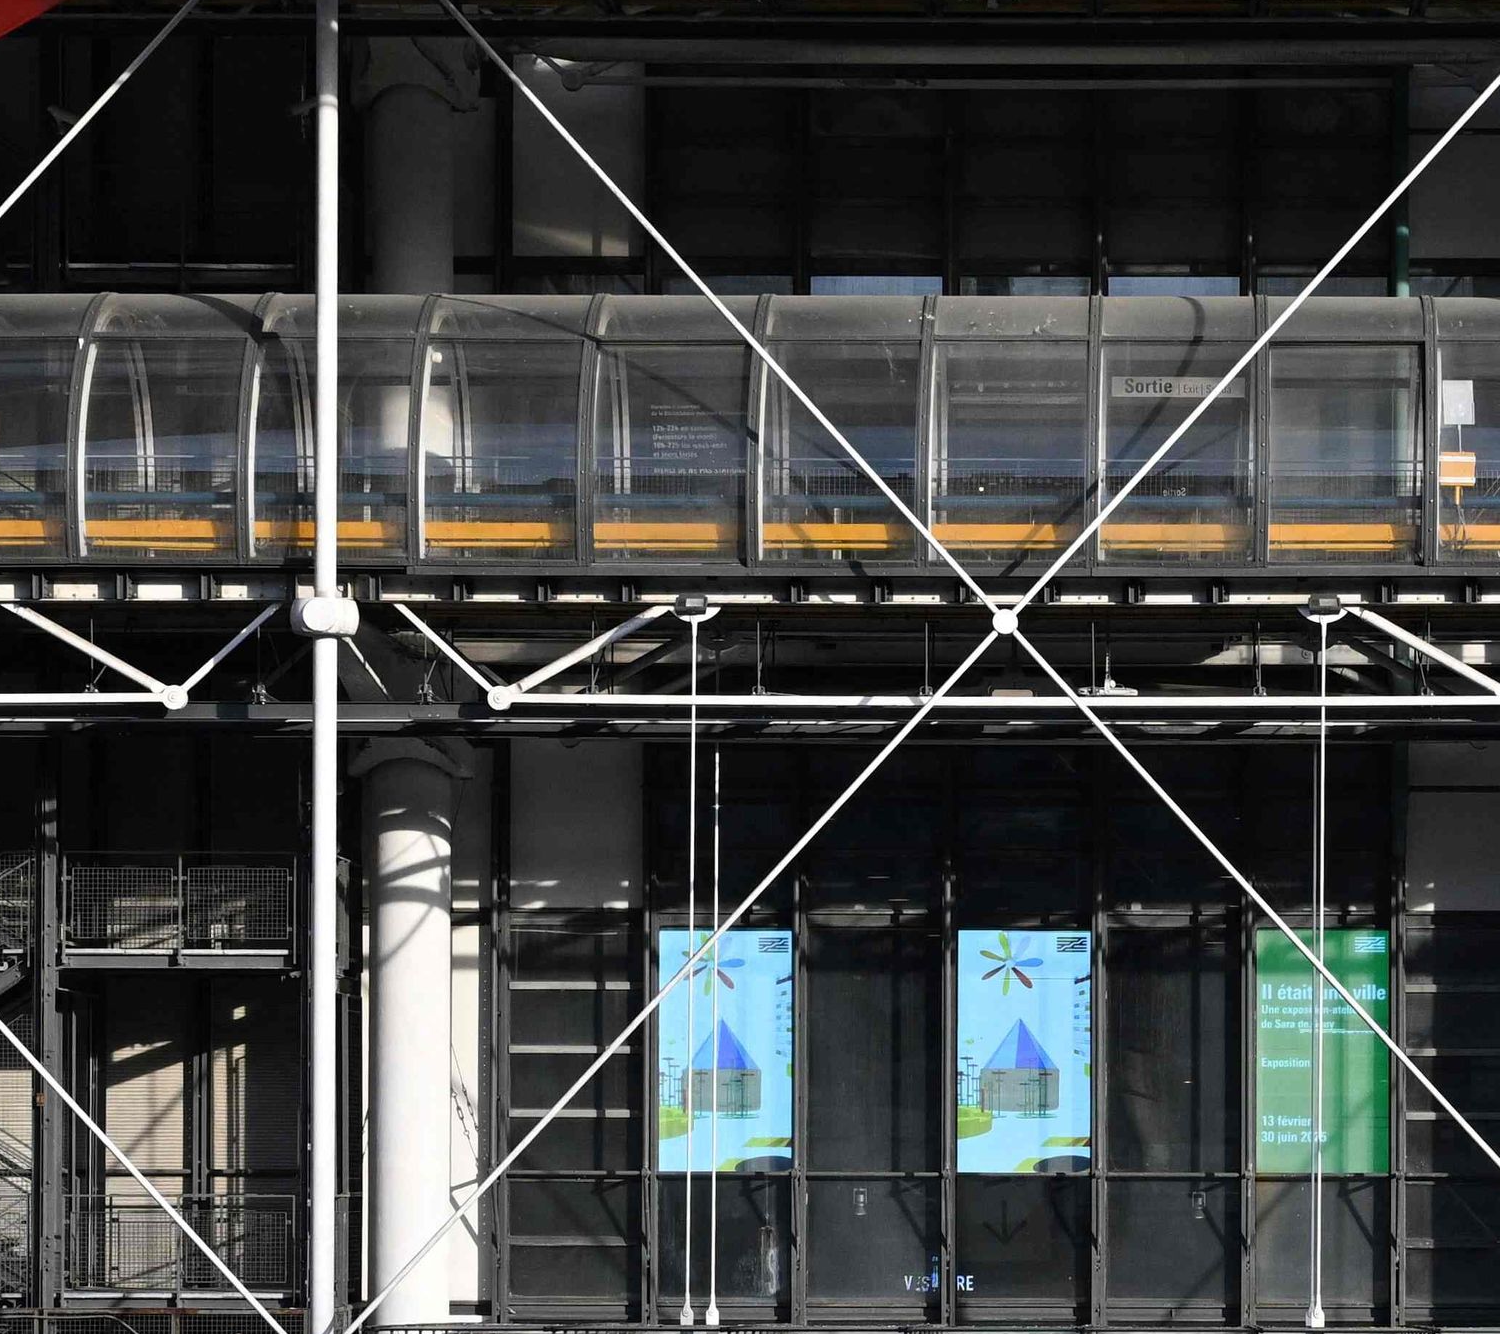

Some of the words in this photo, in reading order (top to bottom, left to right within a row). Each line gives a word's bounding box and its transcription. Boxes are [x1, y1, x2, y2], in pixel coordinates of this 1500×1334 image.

[1124, 378, 1173, 395] Sortie
[1183, 383, 1199, 393] Exit
[1277, 982, 1313, 1000] était
[1352, 982, 1387, 1000] ville
[1261, 1005, 1280, 1015] Une
[1261, 1020, 1273, 1029] de
[1275, 1019, 1297, 1029] Sara
[1261, 1057, 1312, 1070] Exposition
[1262, 1115, 1275, 1127] 13
[1277, 1115, 1312, 1127] février
[1260, 1131, 1275, 1143] 30
[1277, 1131, 1298, 1144] juin
